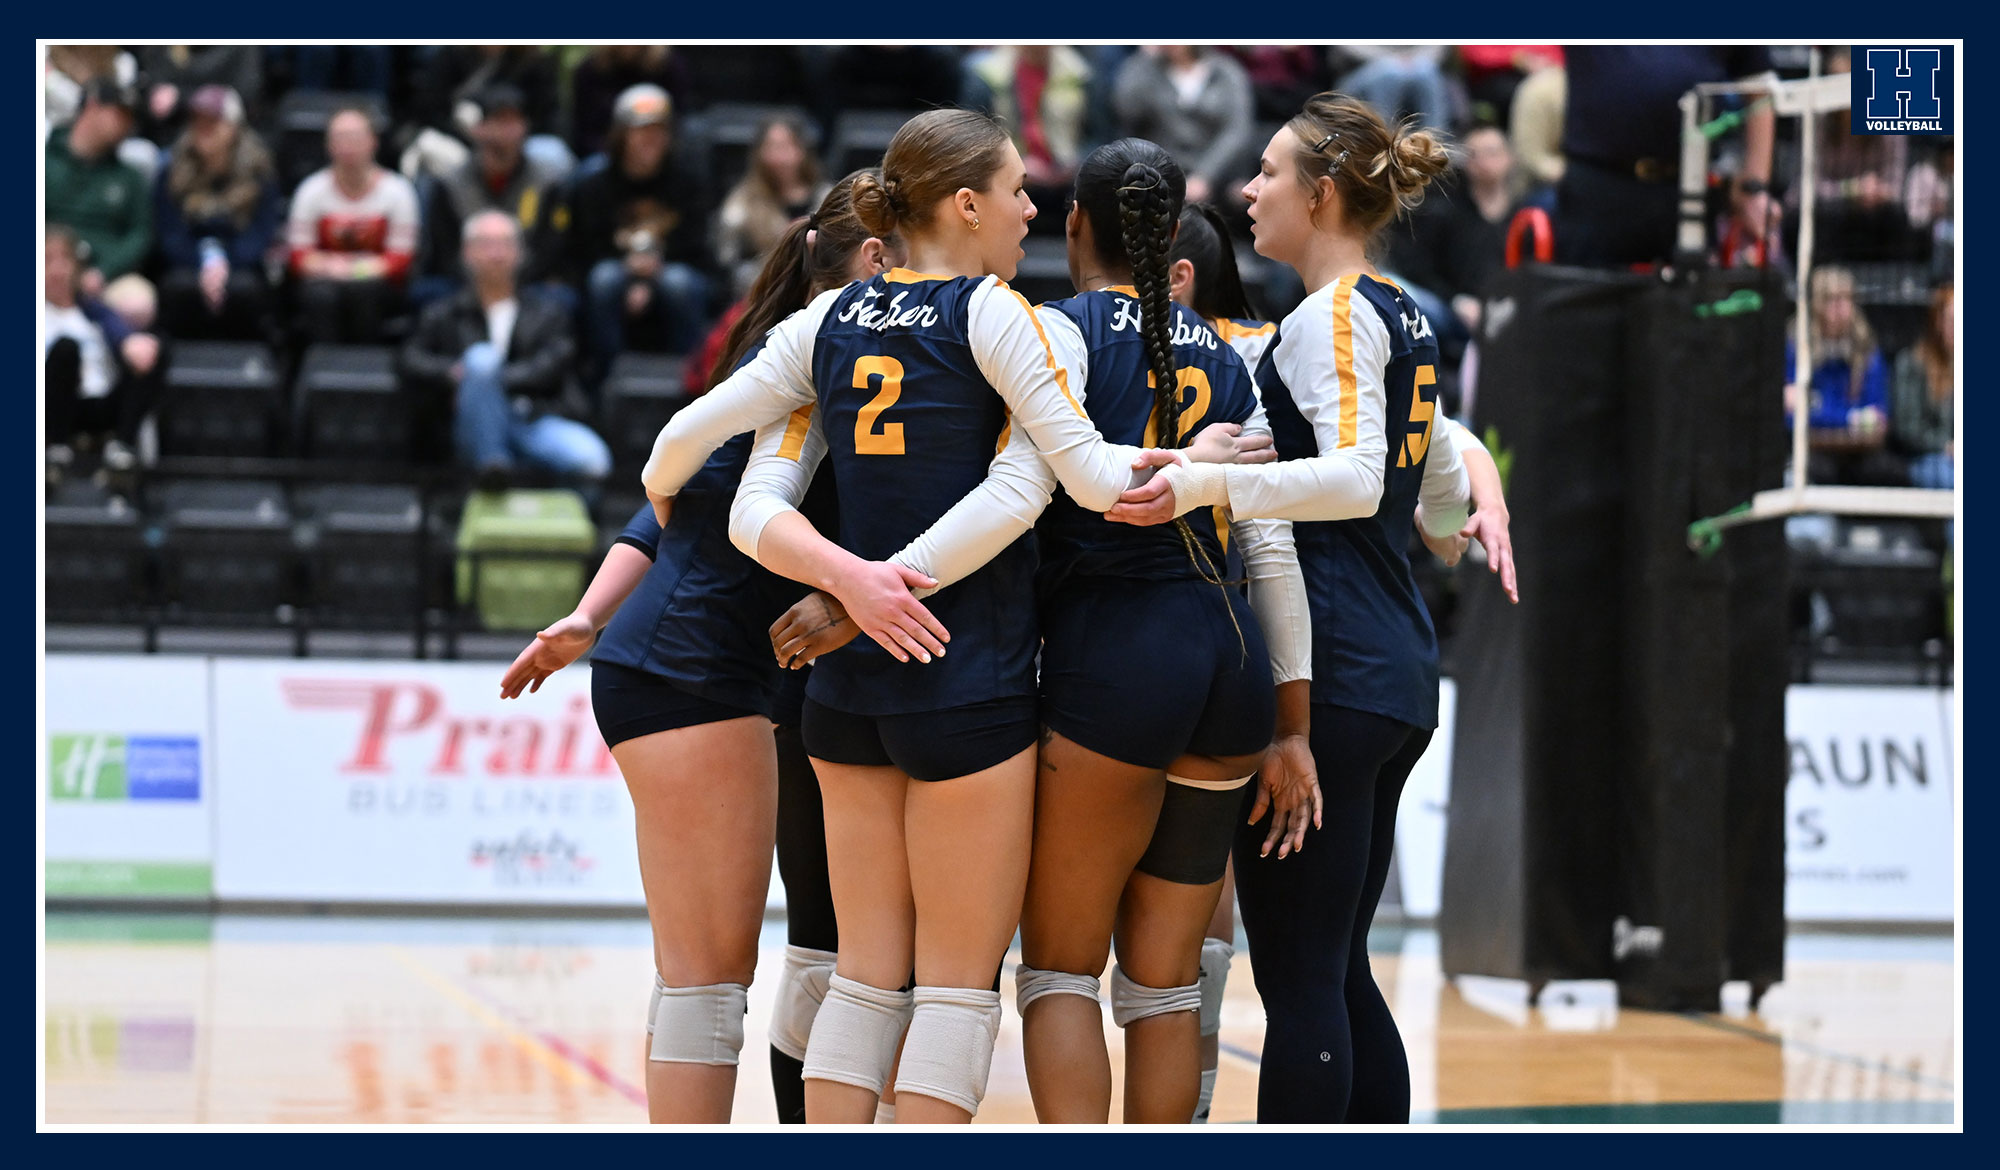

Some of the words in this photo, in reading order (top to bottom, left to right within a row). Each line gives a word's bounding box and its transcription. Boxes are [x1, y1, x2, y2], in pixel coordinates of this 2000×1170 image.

[1110, 298, 1218, 351] Hber
[852, 354, 906, 455] 2
[347, 783, 451, 814] BUS
[474, 784, 619, 815] LINES
